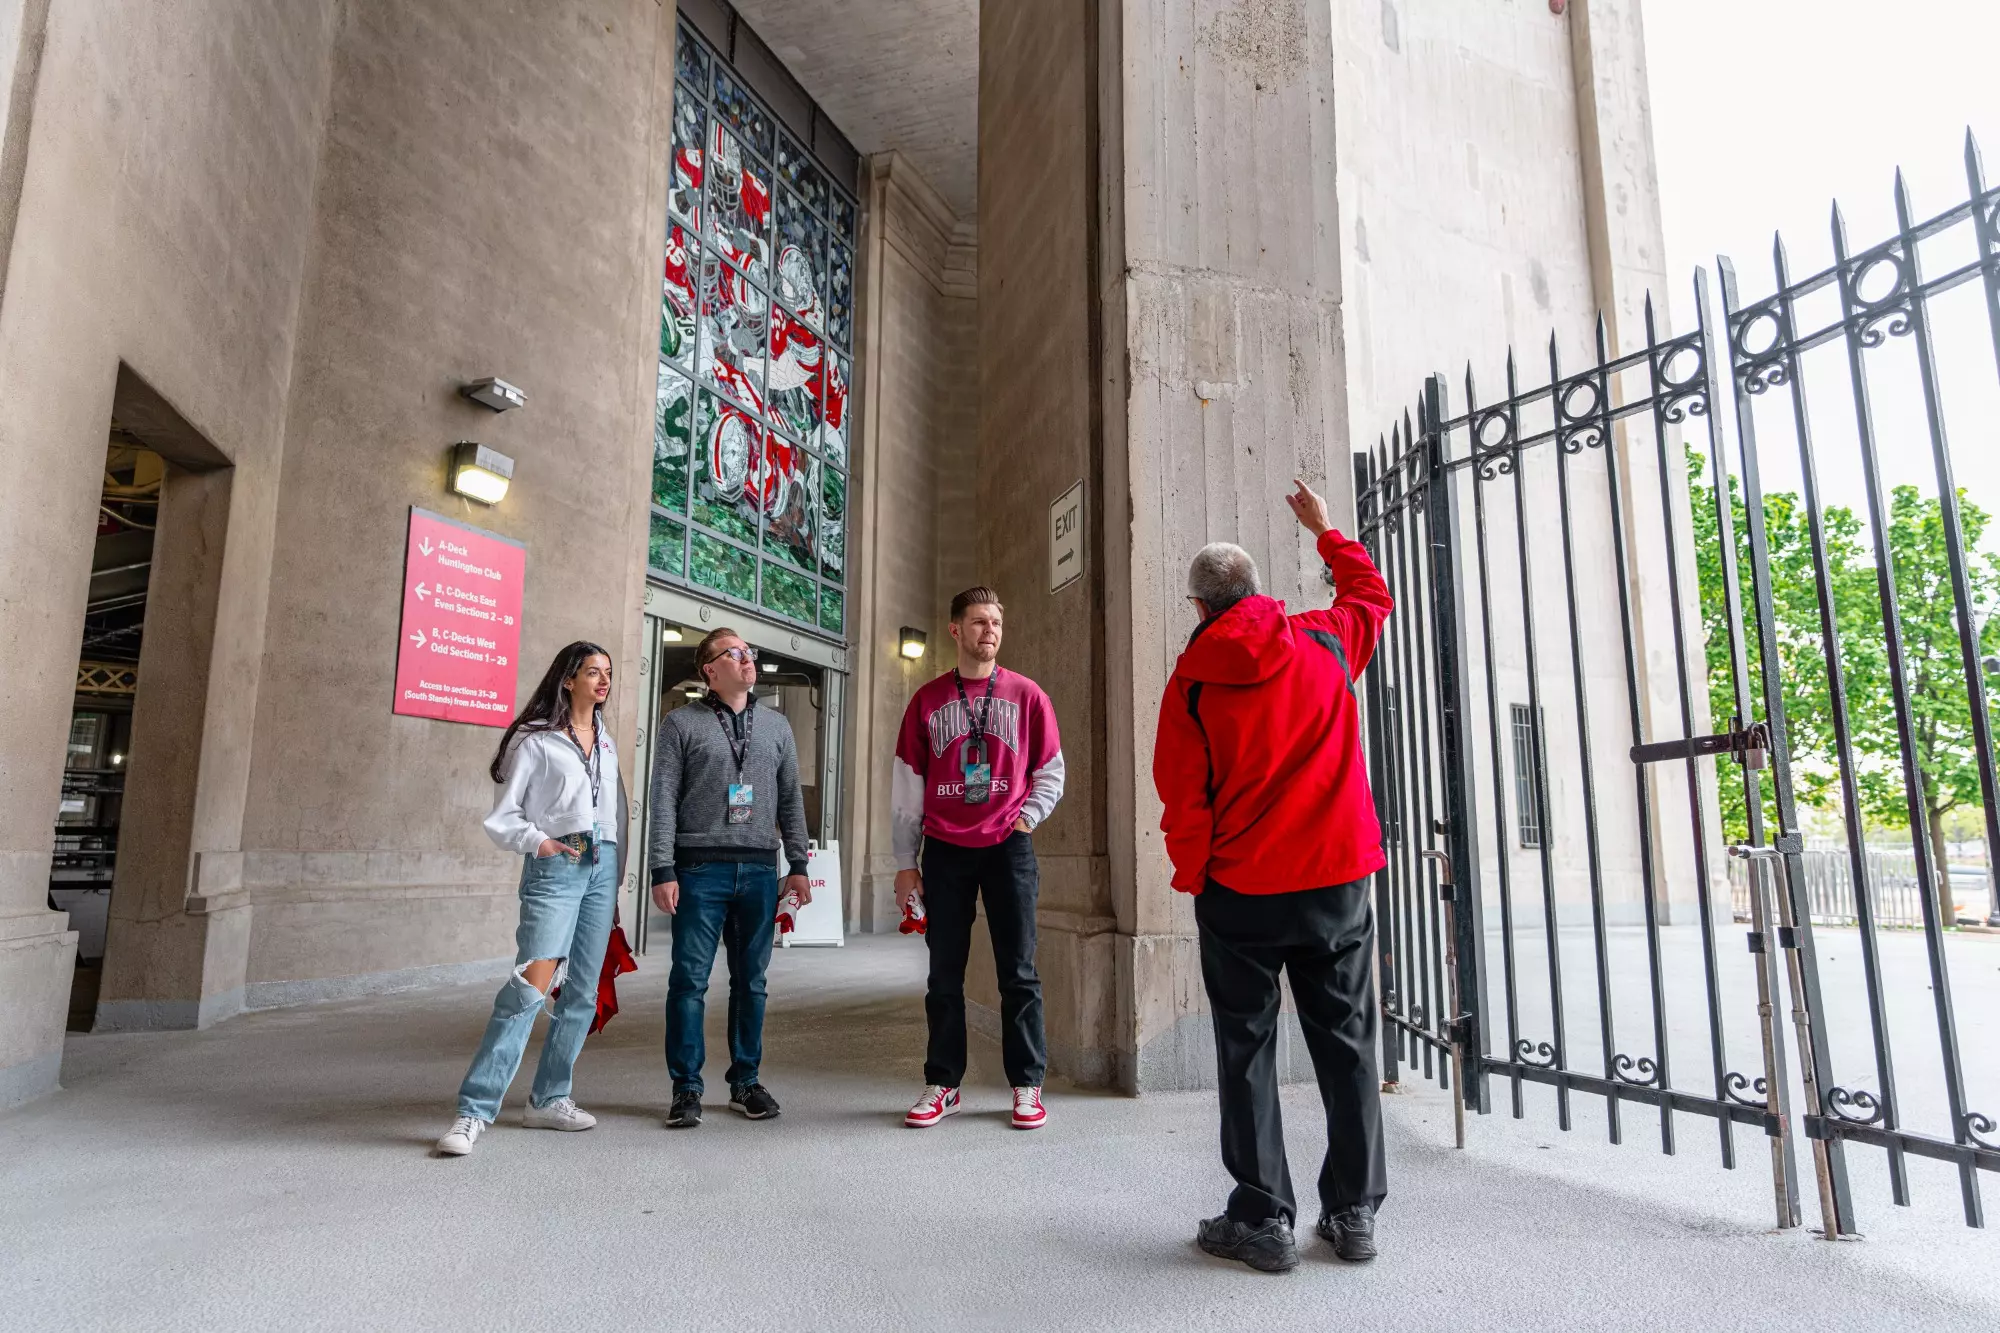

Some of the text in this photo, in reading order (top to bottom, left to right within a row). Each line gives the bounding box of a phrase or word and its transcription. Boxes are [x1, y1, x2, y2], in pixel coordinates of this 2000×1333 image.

[1055, 504, 1077, 541] EXIT
[438, 540, 468, 556] A-Deck
[438, 554, 502, 581] Huntington Club
[436, 583, 497, 608] B, C-Decks East
[434, 598, 455, 612] Even
[456, 603, 490, 620] Sections
[490, 612, 497, 622] 2
[503, 615, 514, 626] 30
[432, 627, 496, 650] B, C-Decks West
[430, 642, 449, 655] Odd
[449, 646, 484, 662] Sections
[484, 653, 490, 663] 1
[496, 656, 508, 666] 29
[419, 680, 443, 691] Access
[451, 686, 478, 697] sections
[404, 690, 509, 713] (South Stands) from A-Deck ONLY
[929, 699, 970, 758] OHIO
[936, 780, 1009, 796] BUCES
